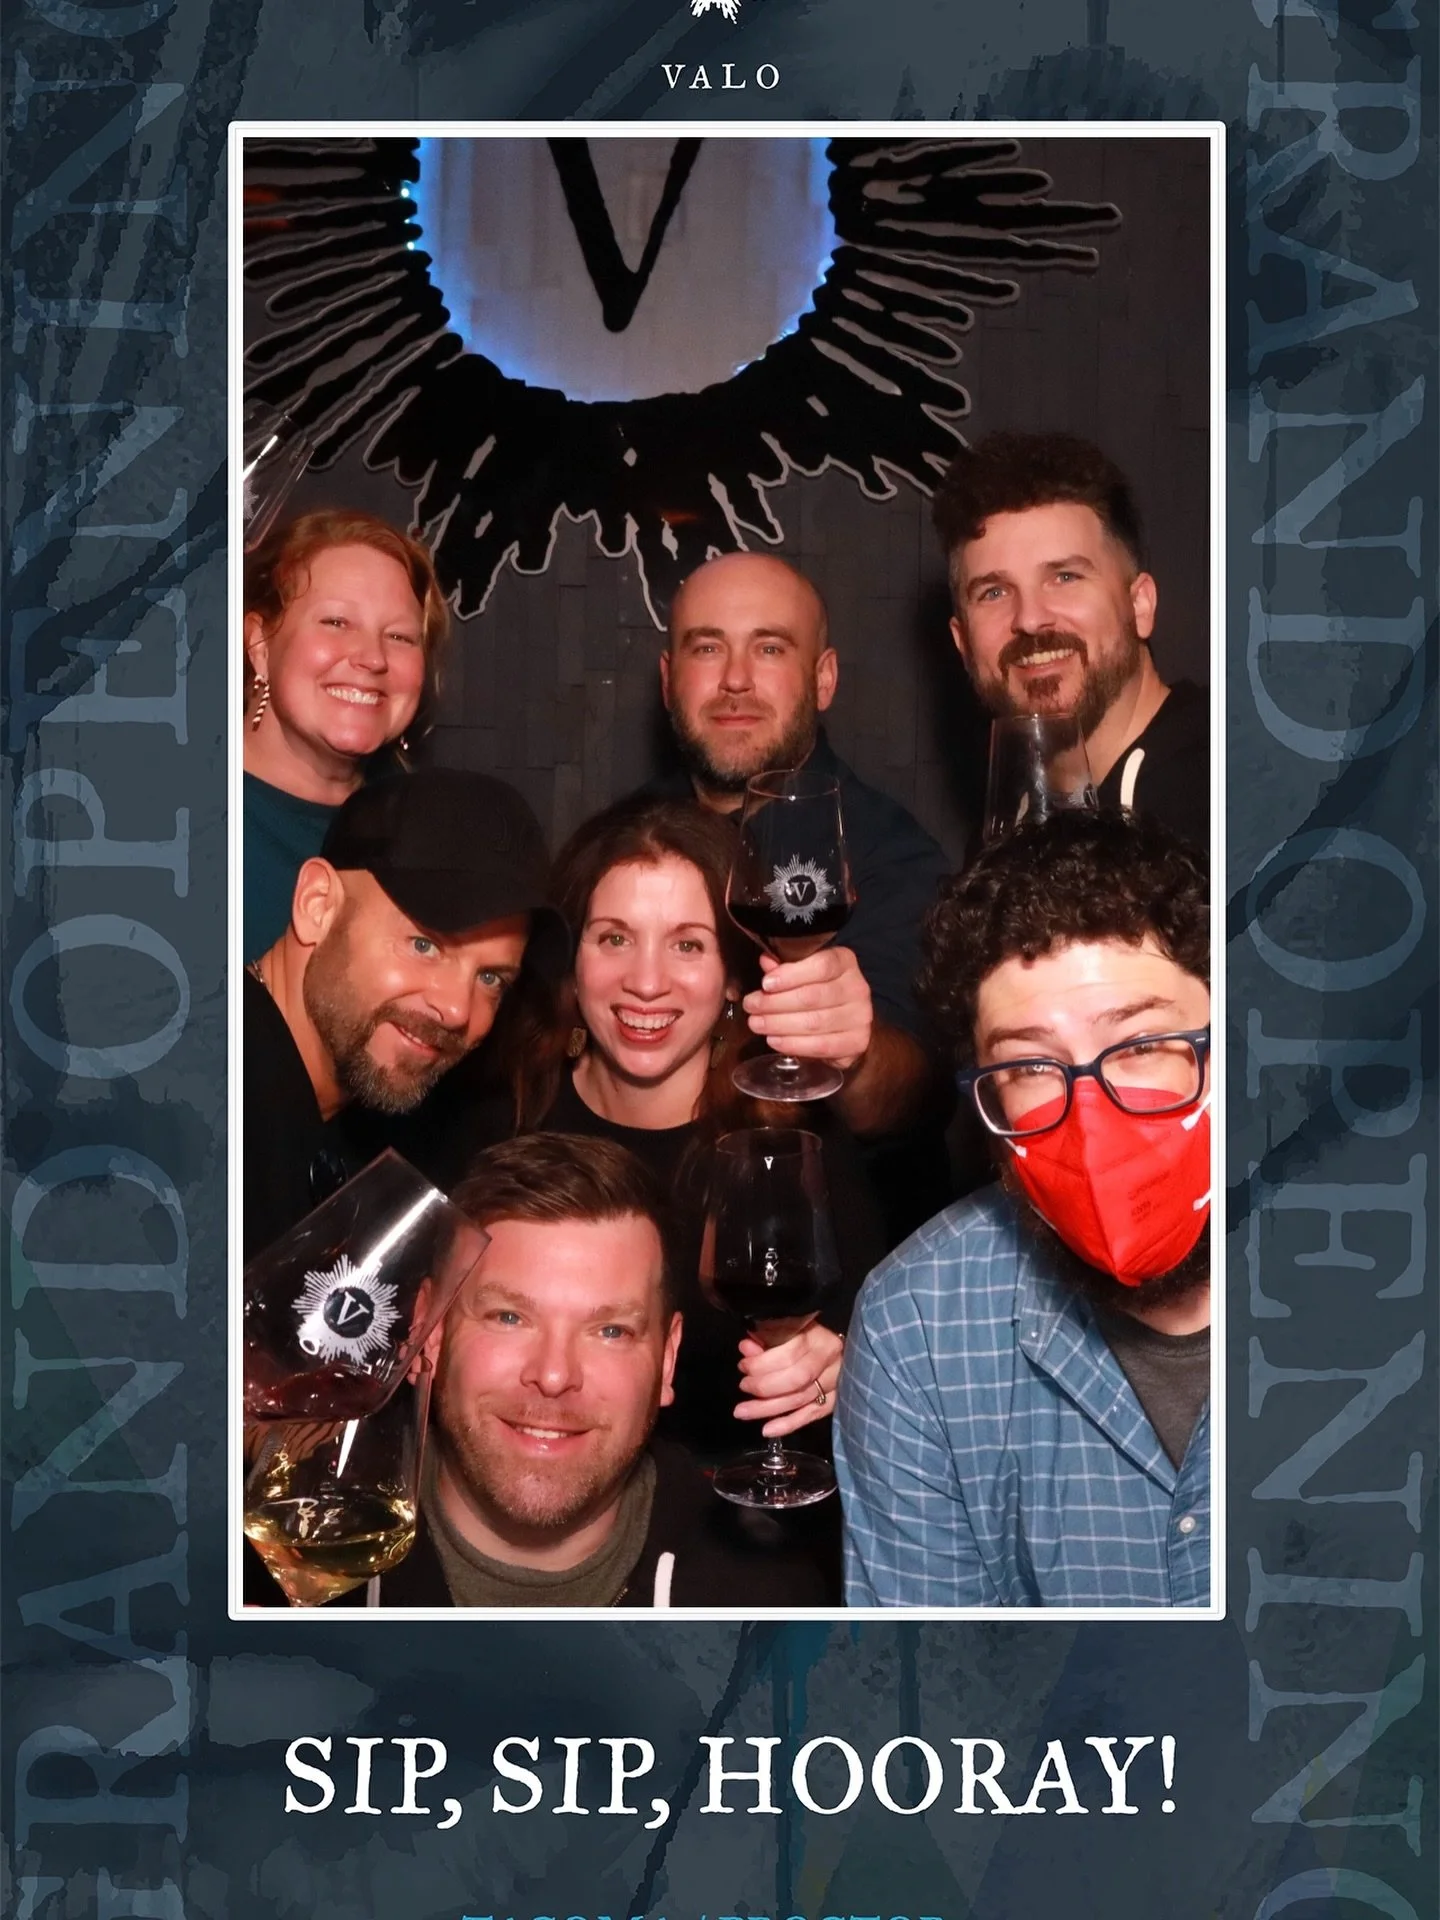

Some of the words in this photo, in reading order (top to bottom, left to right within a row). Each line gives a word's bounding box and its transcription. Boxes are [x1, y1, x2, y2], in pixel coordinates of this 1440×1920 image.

[546, 137, 706, 333] V
[790, 881, 811, 903] V
[336, 1291, 370, 1326] V
